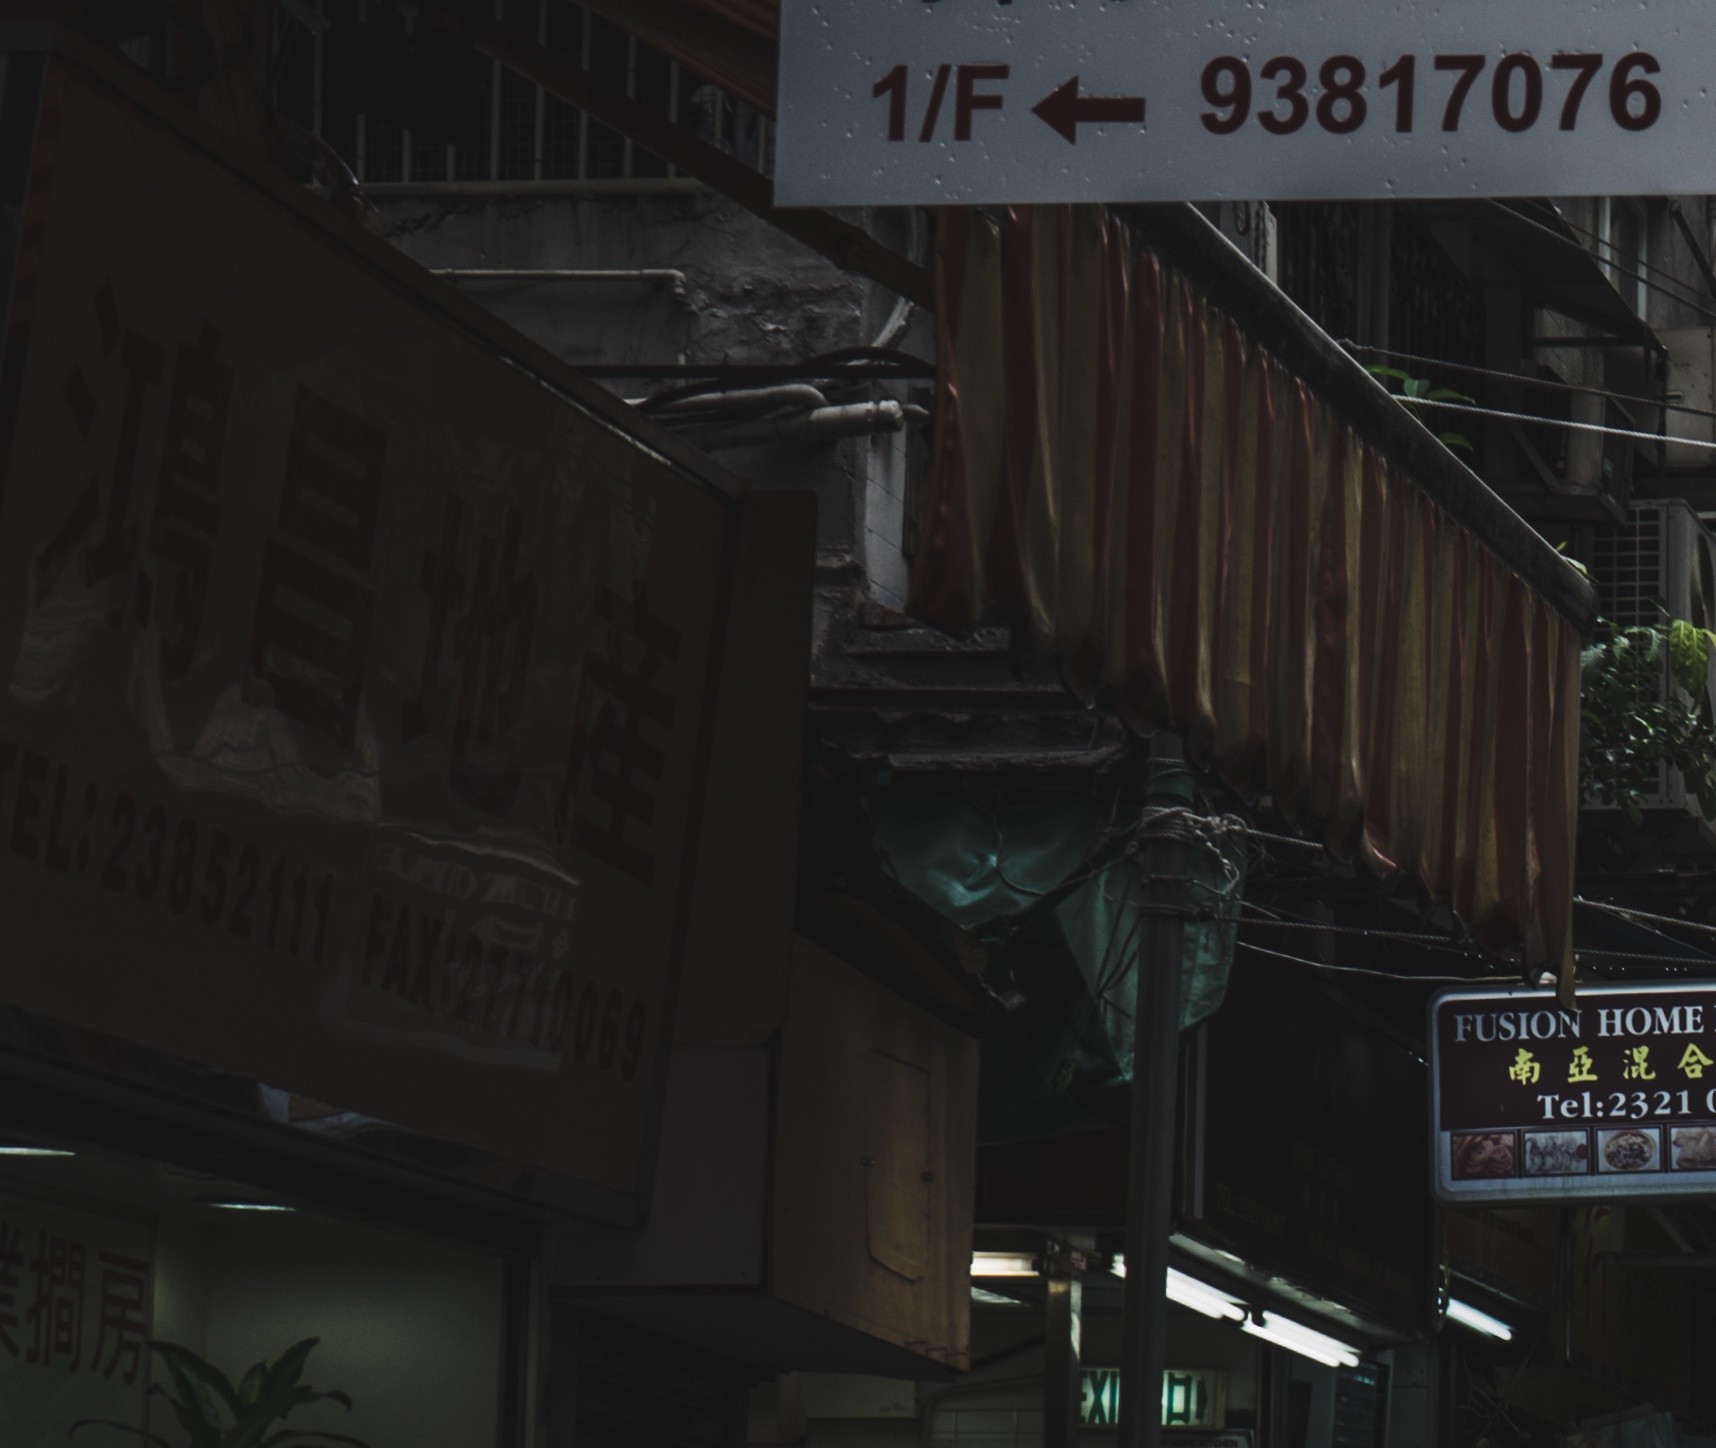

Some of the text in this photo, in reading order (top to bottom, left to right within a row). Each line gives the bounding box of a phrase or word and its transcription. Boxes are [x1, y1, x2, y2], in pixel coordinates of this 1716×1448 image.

[871, 52, 1664, 142] 1/F 93817076
[36, 278, 682, 885] 鴻昌地產
[1453, 1009, 1583, 1044] FUSION
[1596, 1005, 1706, 1038] HOME
[1536, 1089, 1693, 1121] Tel:2321
